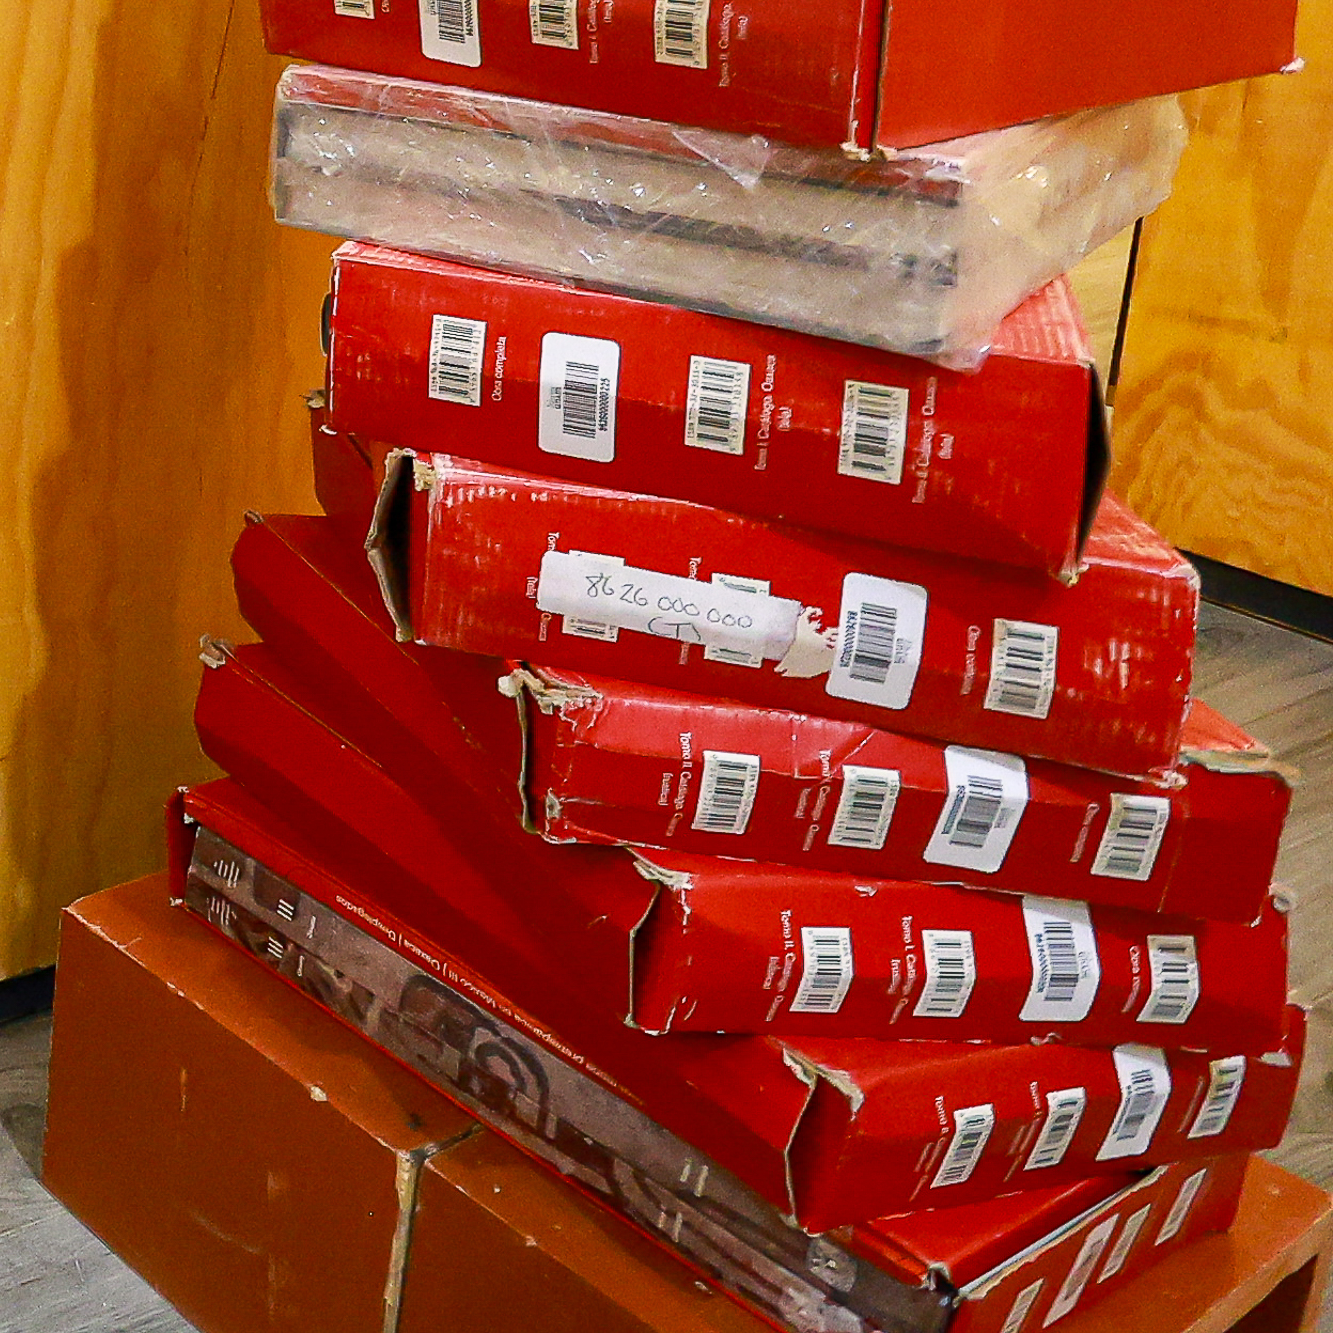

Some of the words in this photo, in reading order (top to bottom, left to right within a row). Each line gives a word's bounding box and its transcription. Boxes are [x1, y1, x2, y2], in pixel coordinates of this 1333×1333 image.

[495, 337, 507, 378] completa
[657, 596, 701, 617] 000
[706, 608, 753, 629] 000
[679, 731, 693, 759] Tomo
[780, 910, 793, 938] Tomo
[900, 916, 914, 943] Tomo
